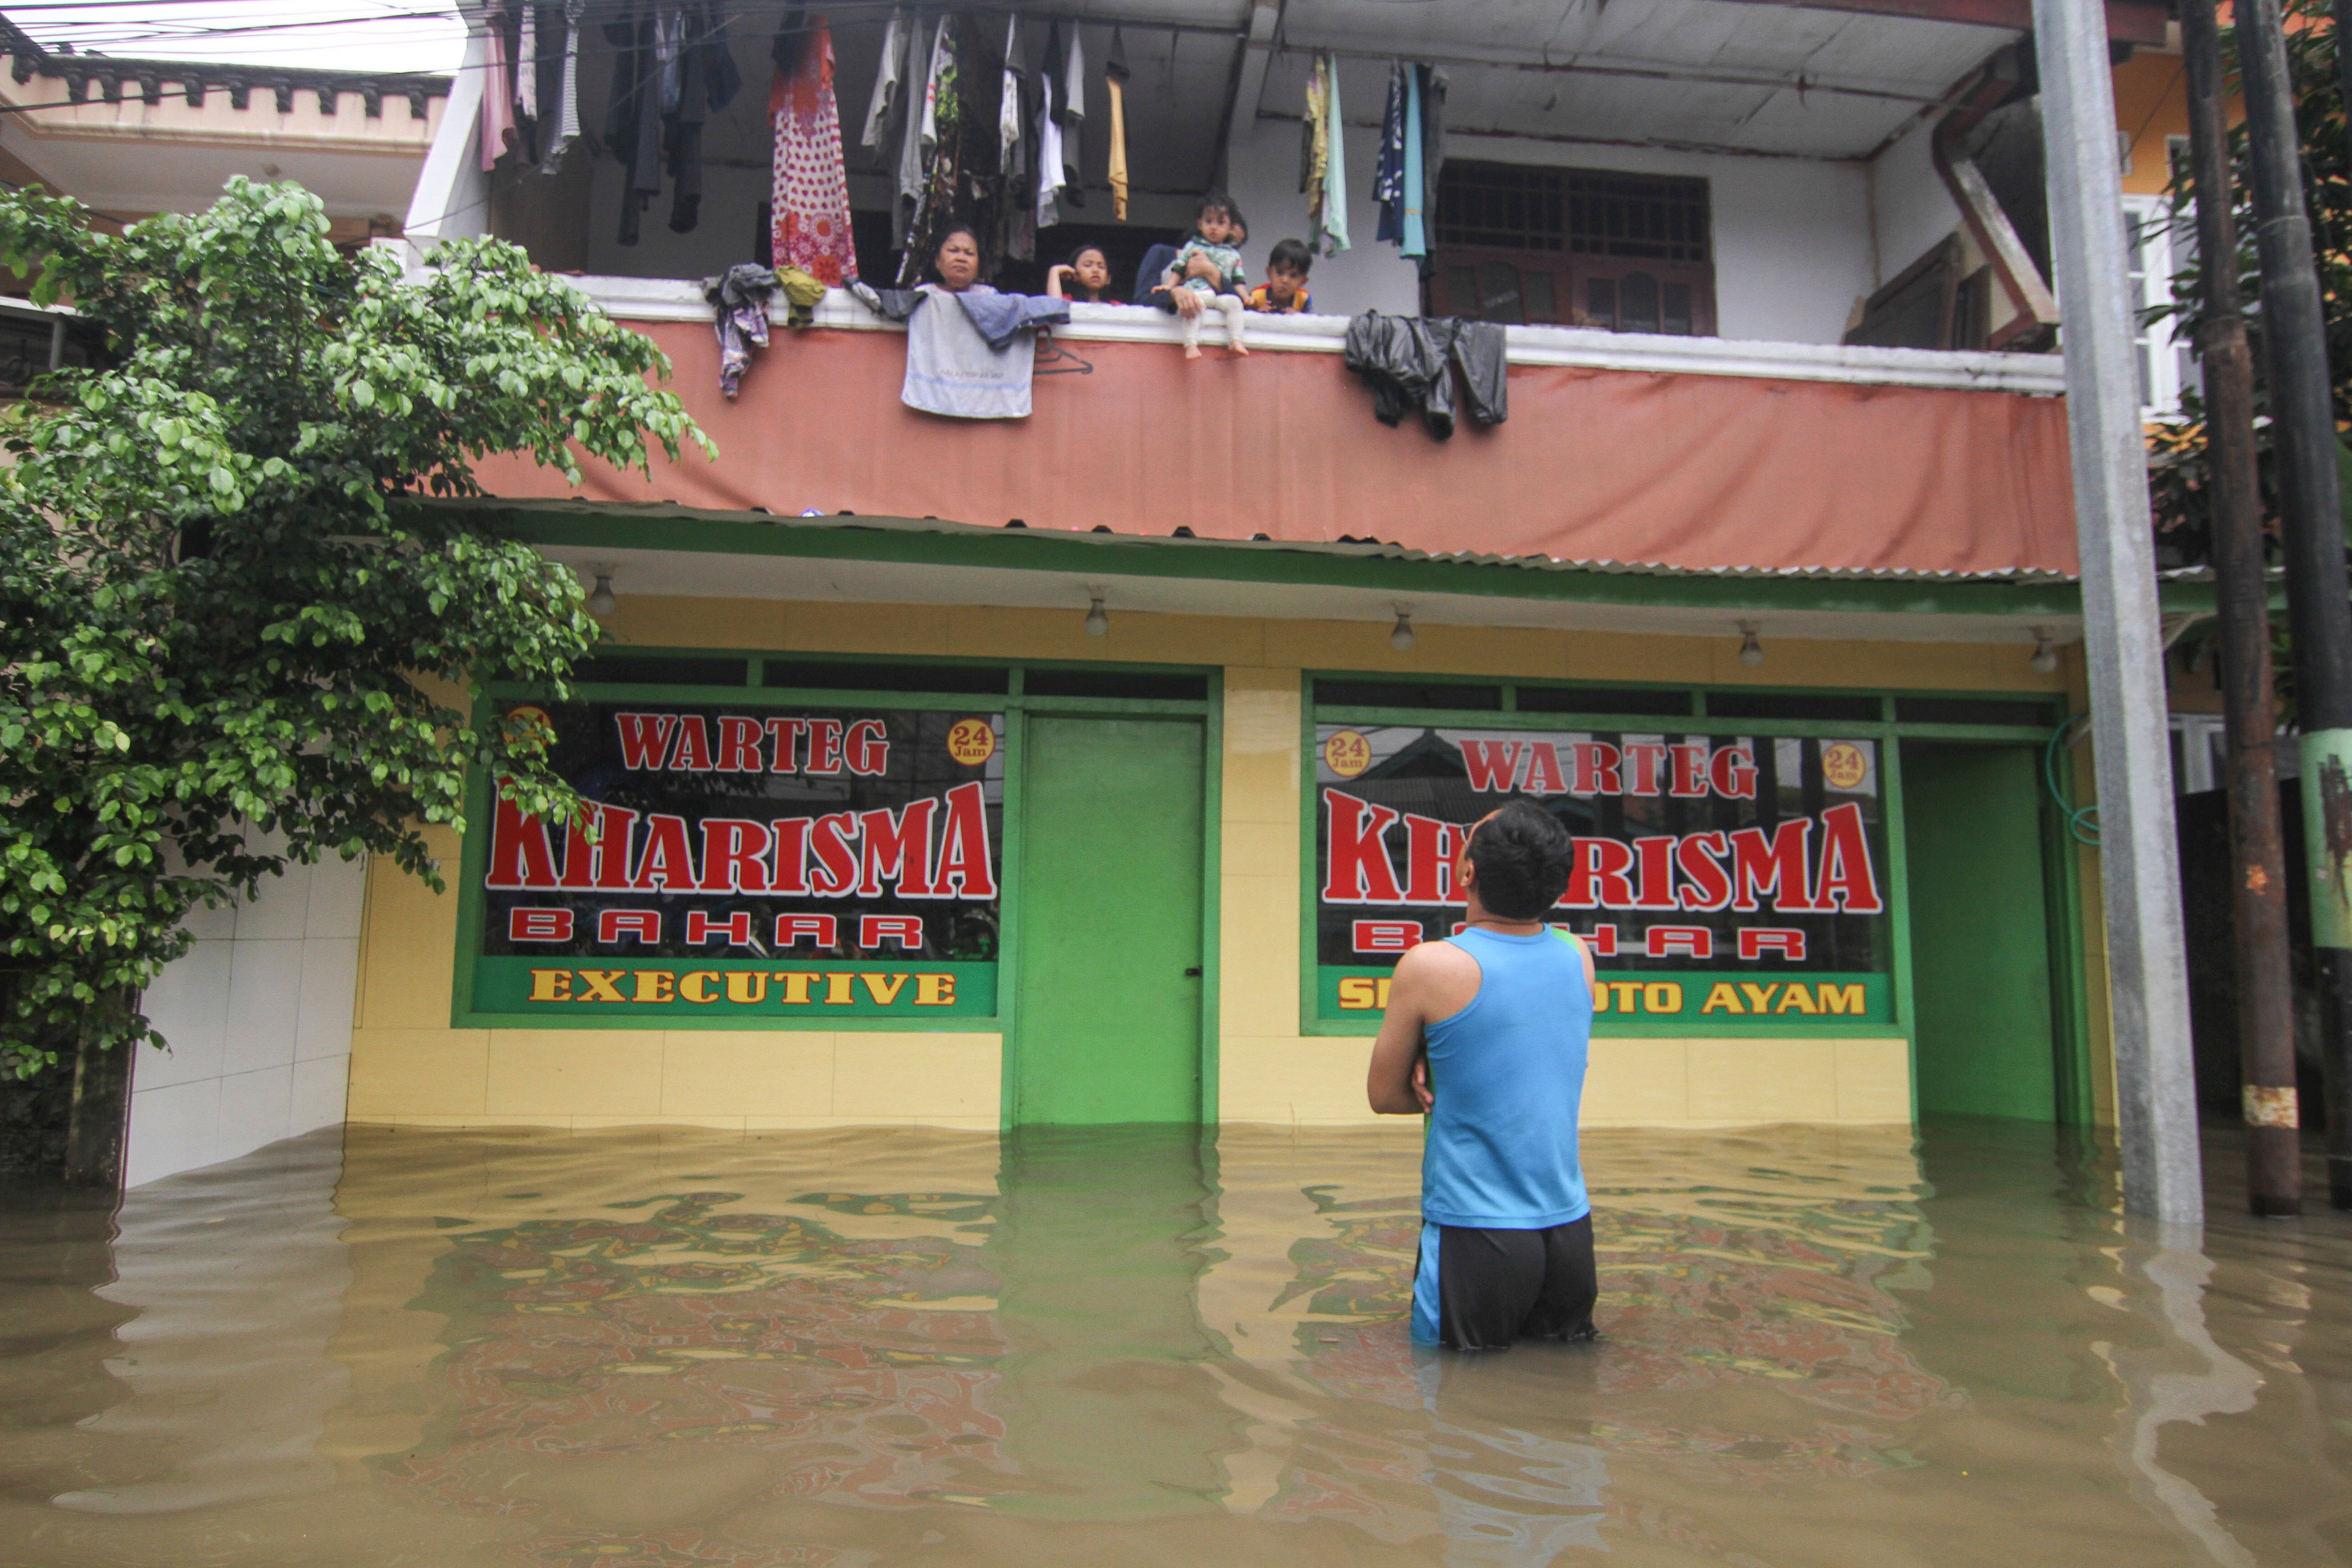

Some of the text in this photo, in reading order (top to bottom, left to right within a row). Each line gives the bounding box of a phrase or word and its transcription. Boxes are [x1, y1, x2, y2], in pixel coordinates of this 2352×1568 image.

[615, 713, 890, 775] WARTEG
[954, 726, 988, 746] 24
[954, 746, 986, 757] Jam
[1331, 737, 1364, 757] 24
[1332, 758, 1363, 768] Jam
[1459, 739, 1758, 800] WARTEG
[1828, 750, 1858, 769] 24
[485, 776, 998, 900] KHARISMA
[1322, 787, 1883, 914] KHRISMA
[509, 907, 924, 948] BAHAR
[1352, 920, 1806, 961] BHAR
[528, 968, 957, 1006] EXECUTIVE
[1699, 982, 1866, 1016] AYAM
